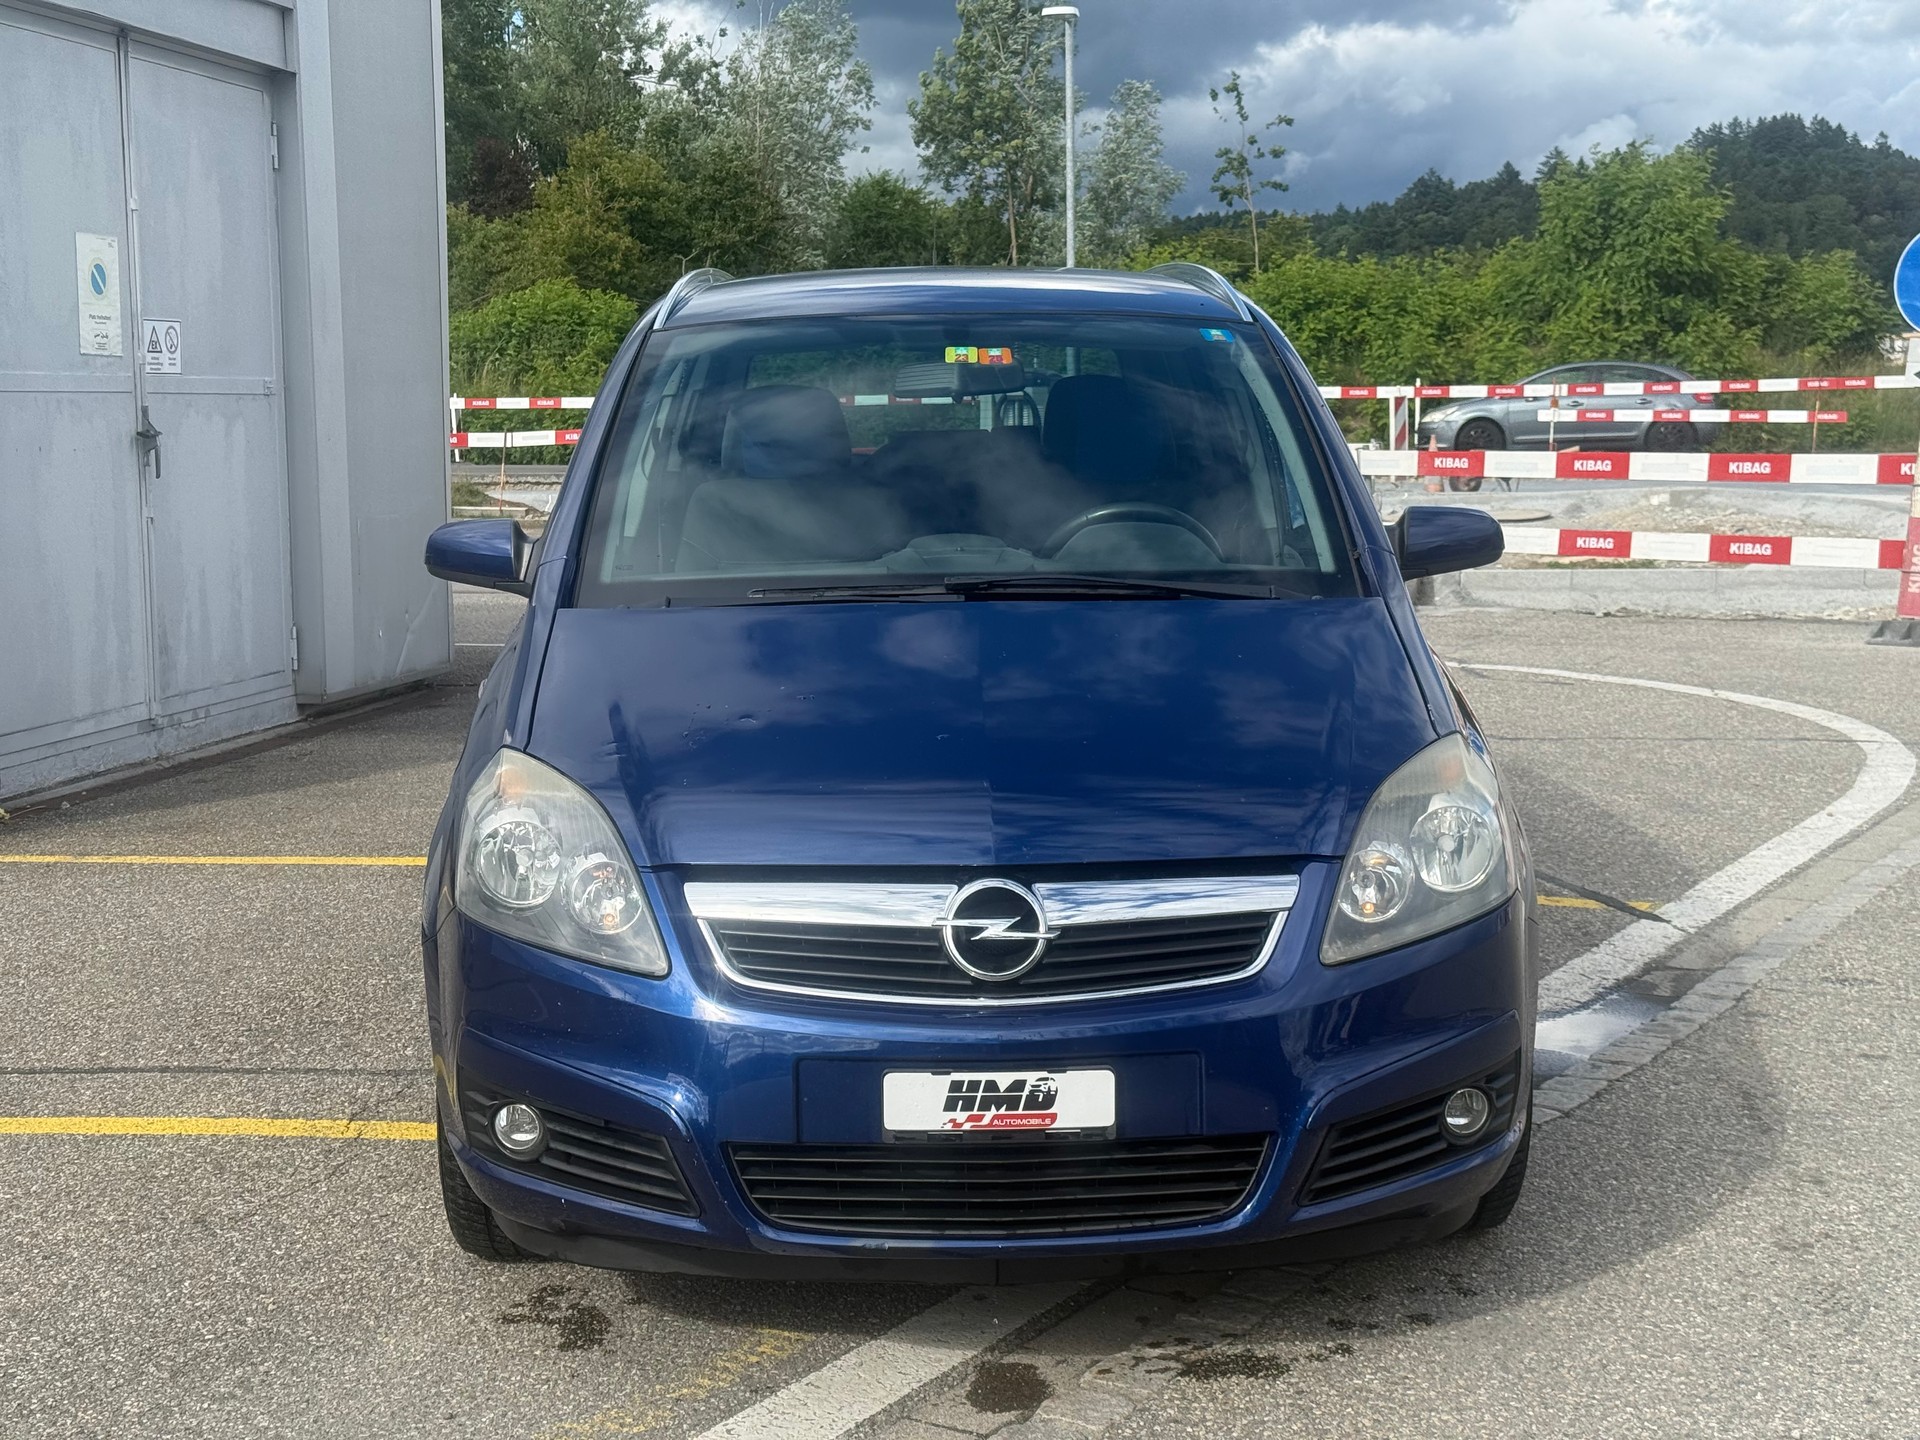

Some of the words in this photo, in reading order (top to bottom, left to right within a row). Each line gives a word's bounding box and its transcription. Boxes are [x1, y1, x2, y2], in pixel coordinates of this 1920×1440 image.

[1434, 457, 1469, 469] KIBAG
[1574, 459, 1612, 471] KIBAG
[1728, 461, 1771, 474] KIBAG
[1576, 536, 1614, 549] KIBAG
[1729, 542, 1772, 555] KIBAG
[992, 1118, 1051, 1126] AUTOMOBILE
